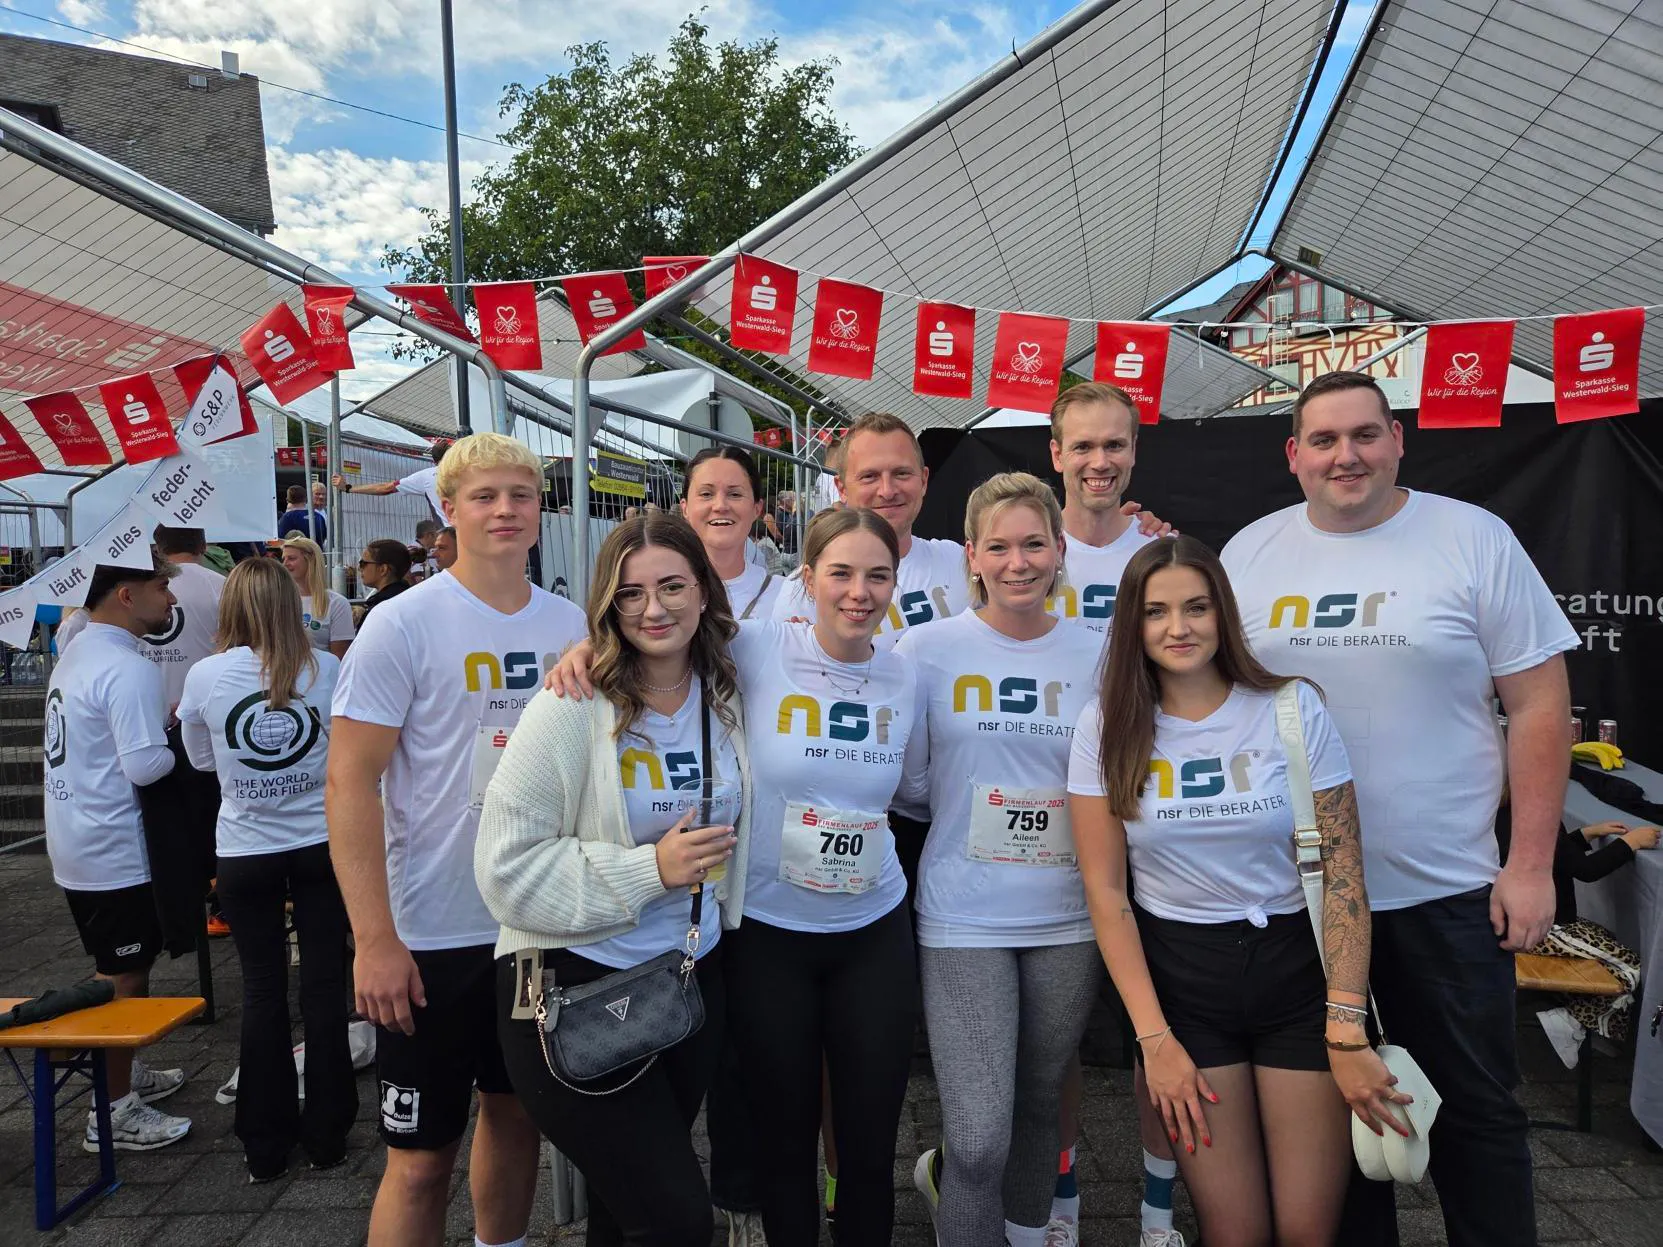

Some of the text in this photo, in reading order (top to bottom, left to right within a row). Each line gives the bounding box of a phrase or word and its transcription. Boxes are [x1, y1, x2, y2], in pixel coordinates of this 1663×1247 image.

[745, 314, 776, 325] Sparkasse
[736, 320, 786, 336] Westerwald-Sieg
[485, 335, 534, 346] Wir für die Region
[816, 336, 828, 346] Wir
[827, 339, 838, 348] für
[849, 341, 871, 352] Region
[277, 358, 307, 377] Sparkasse
[920, 367, 966, 379] Westerwald-Sieg
[928, 361, 956, 370] Sparkasse
[996, 370, 1054, 387] Wir für die Region
[1575, 377, 1616, 389] Sparkasse
[1427, 386, 1497, 399] Wir für die Region
[1563, 384, 1629, 399] Westerwald-Sieg
[201, 389, 223, 425] S&P
[126, 431, 169, 447] Westerwald-Sieg
[131, 427, 158, 438] Sparkasse
[152, 463, 193, 508] feder-
[173, 478, 215, 525] leicht
[107, 525, 142, 559] alles
[48, 566, 88, 598] läuft
[1269, 592, 1386, 629] nsr
[1289, 635, 1411, 647] nsr DIE BERATER.
[953, 674, 1063, 717] nsr
[489, 699, 507, 710] nsr
[777, 694, 893, 745] nsr
[978, 721, 1000, 731] nsr
[1005, 723, 1025, 733] DIE
[805, 747, 829, 758] nsr
[835, 749, 858, 761] DIE
[233, 772, 309, 789] THE WORLD
[236, 789, 245, 799] IS
[248, 788, 278, 799] OUR
[652, 801, 673, 812] nsr
[1047, 799, 1065, 808] 2025
[1157, 795, 1287, 819] nsr DIE BERATER.
[818, 818, 863, 829] FIRMENLAUF
[1006, 810, 1049, 832] 759
[820, 831, 863, 856] 760
[1012, 833, 1040, 842] Aileen
[821, 857, 856, 867] Sabrina
